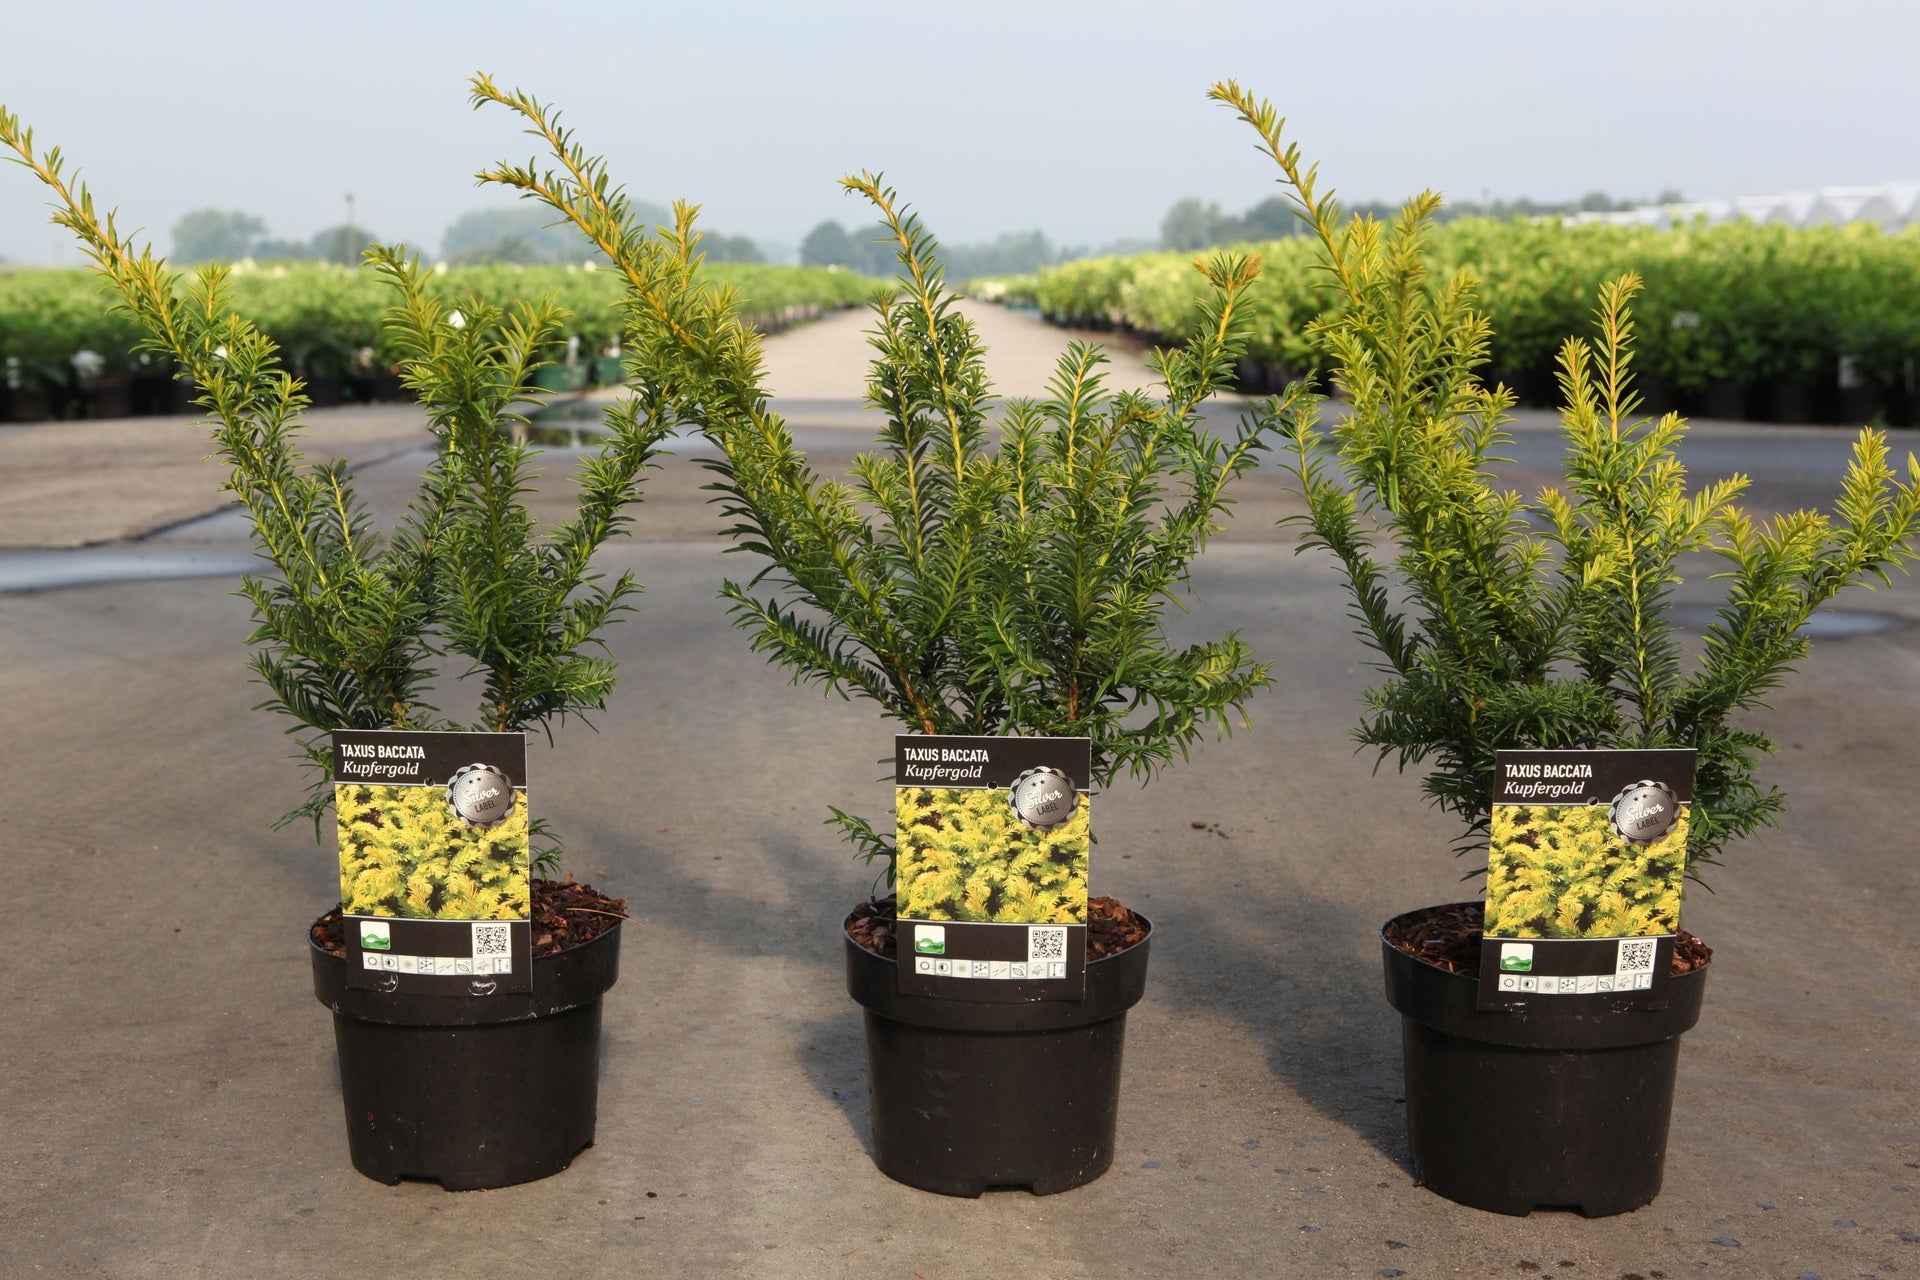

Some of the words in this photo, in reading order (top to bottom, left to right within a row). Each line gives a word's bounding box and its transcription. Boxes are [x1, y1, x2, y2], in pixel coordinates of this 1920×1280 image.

[340, 744, 376, 758] TAXUS
[377, 745, 426, 759] BACCATA
[904, 748, 939, 762] TAXUS
[941, 749, 989, 763] BACCATA
[342, 761, 420, 777] Kupfergold
[905, 764, 983, 781] Kupfergold
[1505, 764, 1541, 778] TAXUS
[1543, 764, 1593, 778] BACCATA
[462, 786, 500, 807] Silver
[1503, 781, 1585, 798] Kupfergold
[474, 801, 498, 813] LABEL
[1025, 790, 1063, 809] Silver
[1036, 804, 1060, 816] LABEL
[1626, 804, 1665, 824] Silver
[1636, 818, 1660, 830] LABEL
